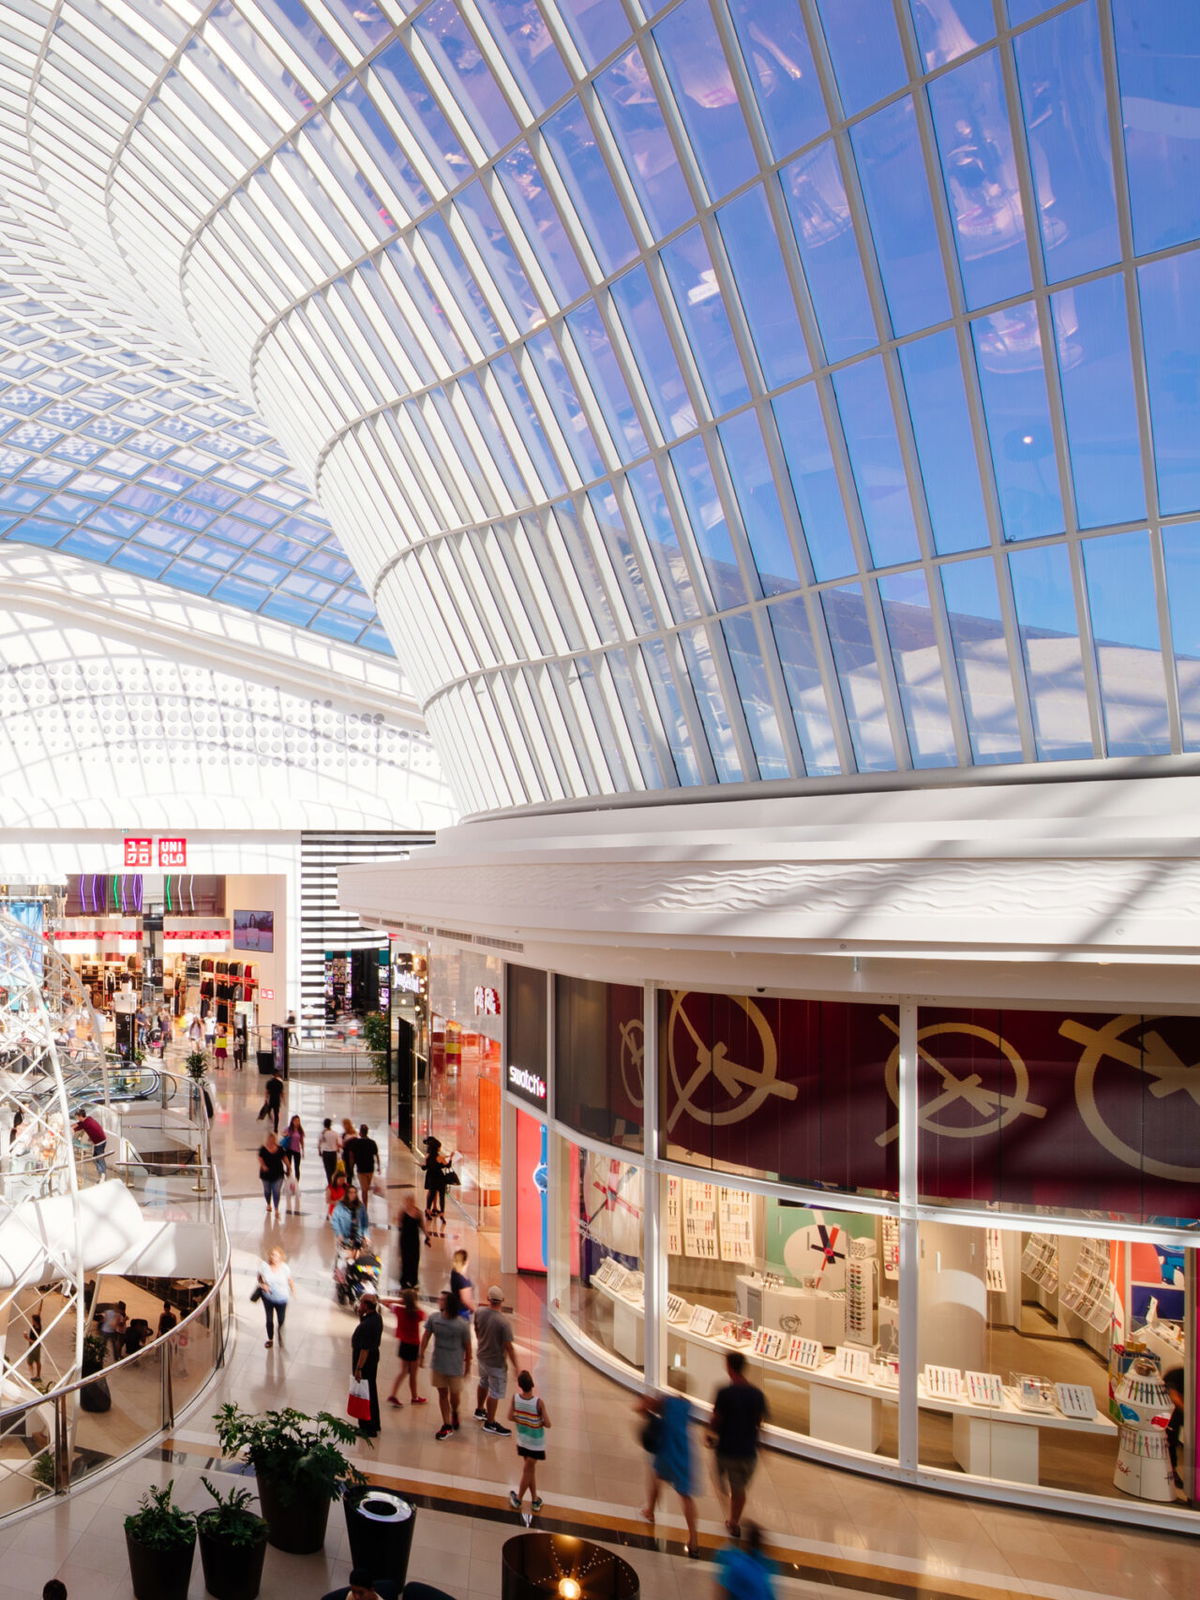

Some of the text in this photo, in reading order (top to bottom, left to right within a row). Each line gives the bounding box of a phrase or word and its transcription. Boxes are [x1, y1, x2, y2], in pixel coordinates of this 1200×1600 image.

[161, 841, 182, 852] UNI
[161, 853, 184, 866] QLO
[509, 1065, 540, 1098] swatch
